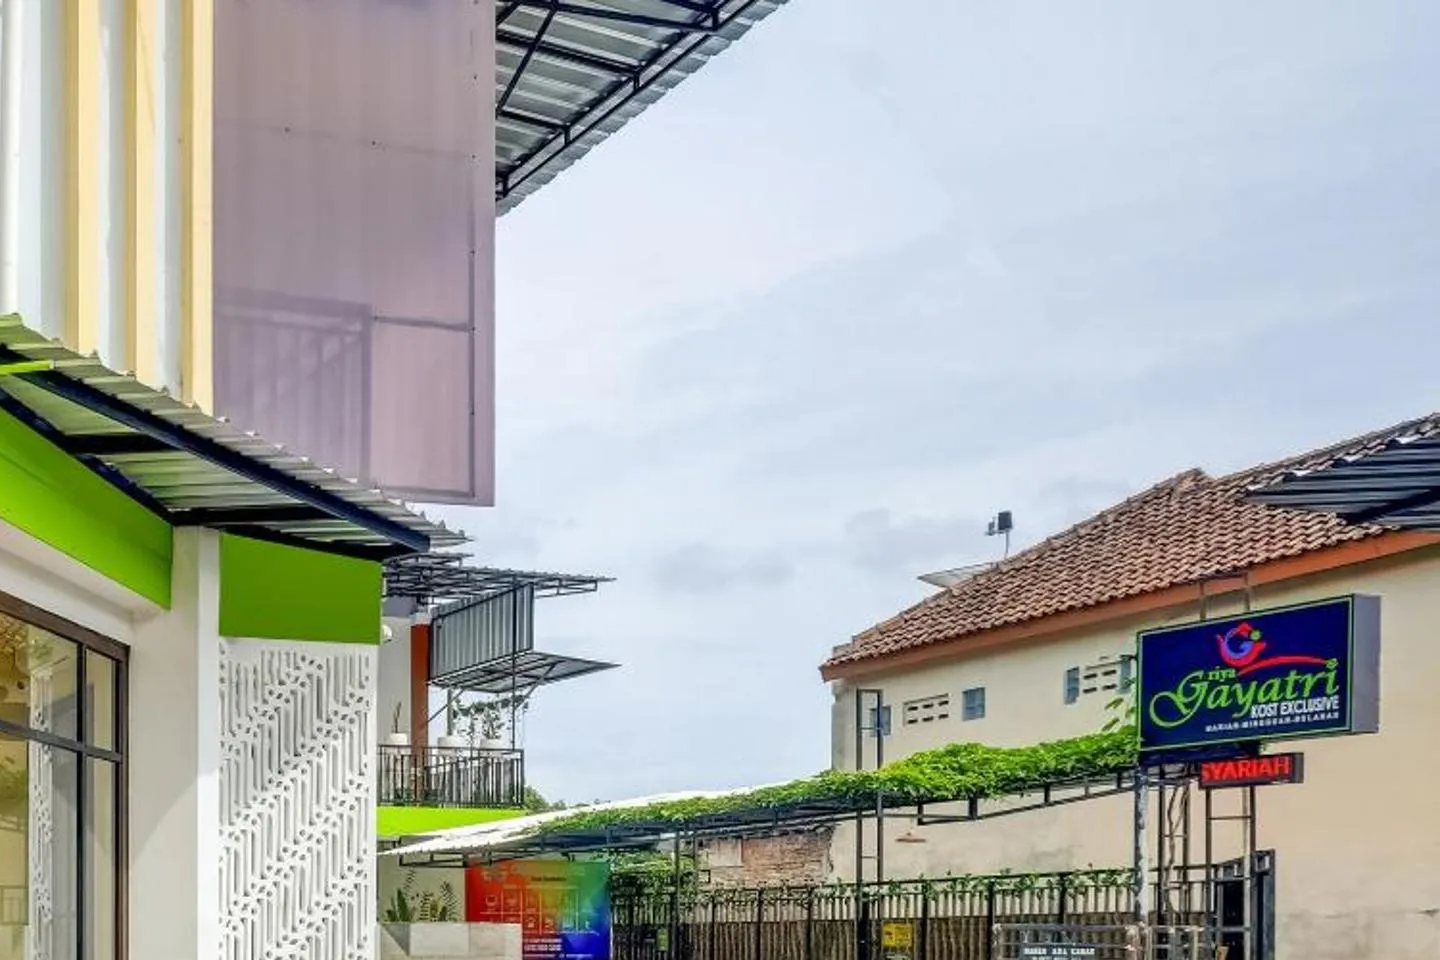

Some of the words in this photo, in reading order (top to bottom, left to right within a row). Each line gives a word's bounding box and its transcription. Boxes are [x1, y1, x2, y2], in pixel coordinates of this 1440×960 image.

[1149, 658, 1341, 728] Gayatri
[1251, 702, 1279, 719] KOST
[1280, 695, 1340, 715] EXCLUSIVE
[1201, 756, 1291, 781] SYARIAH
